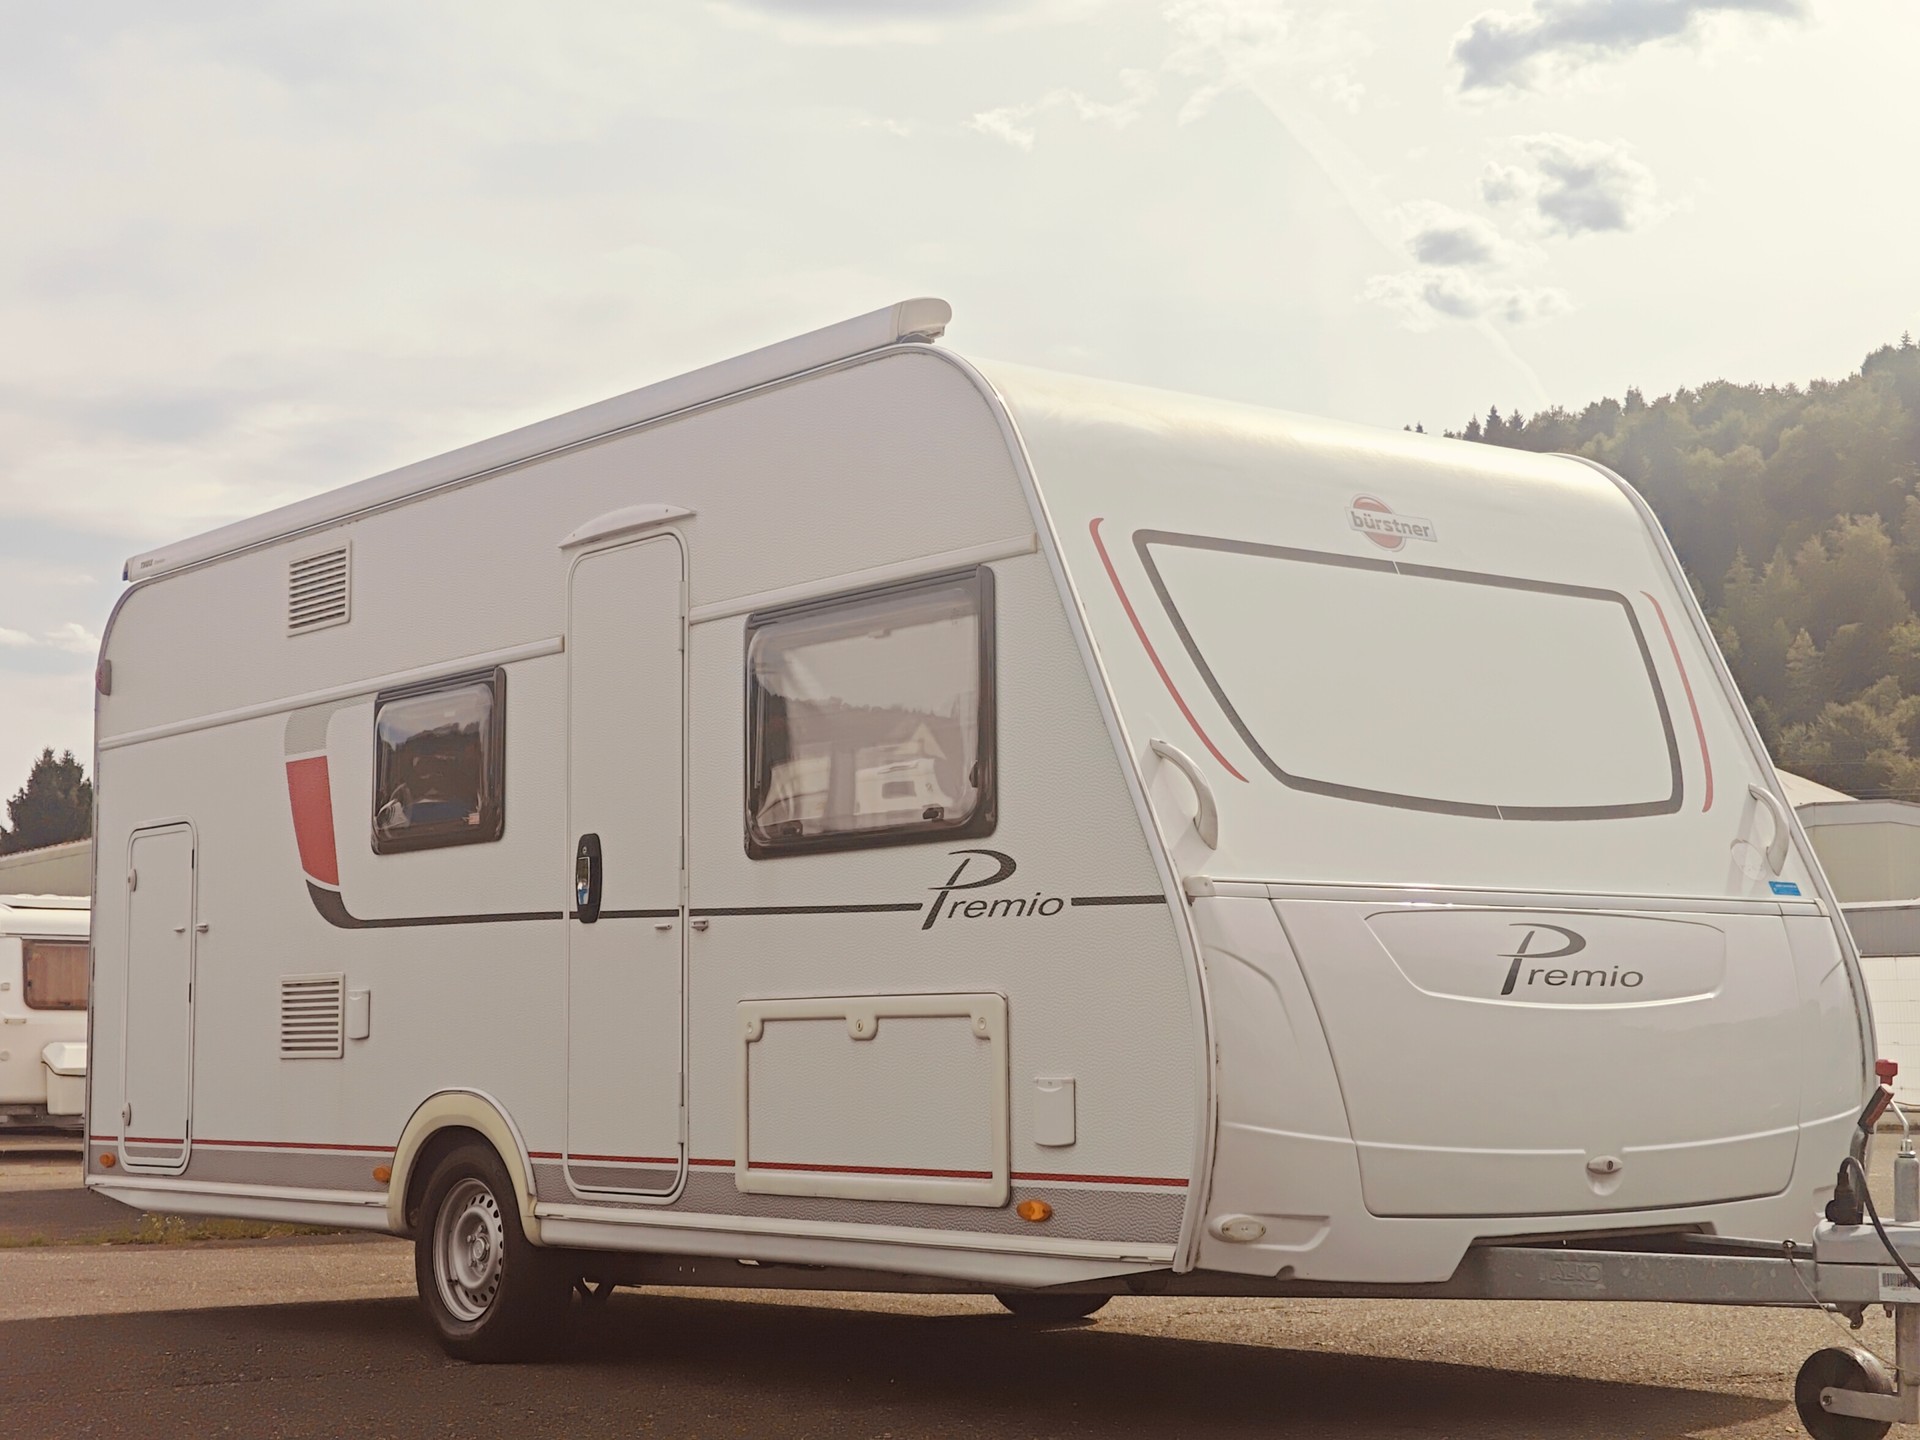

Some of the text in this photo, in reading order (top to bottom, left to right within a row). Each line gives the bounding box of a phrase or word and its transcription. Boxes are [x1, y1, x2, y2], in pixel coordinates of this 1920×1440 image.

[1350, 510, 1430, 537] bürstner
[921, 849, 1064, 930] Premio
[1496, 923, 1643, 995] Premio
